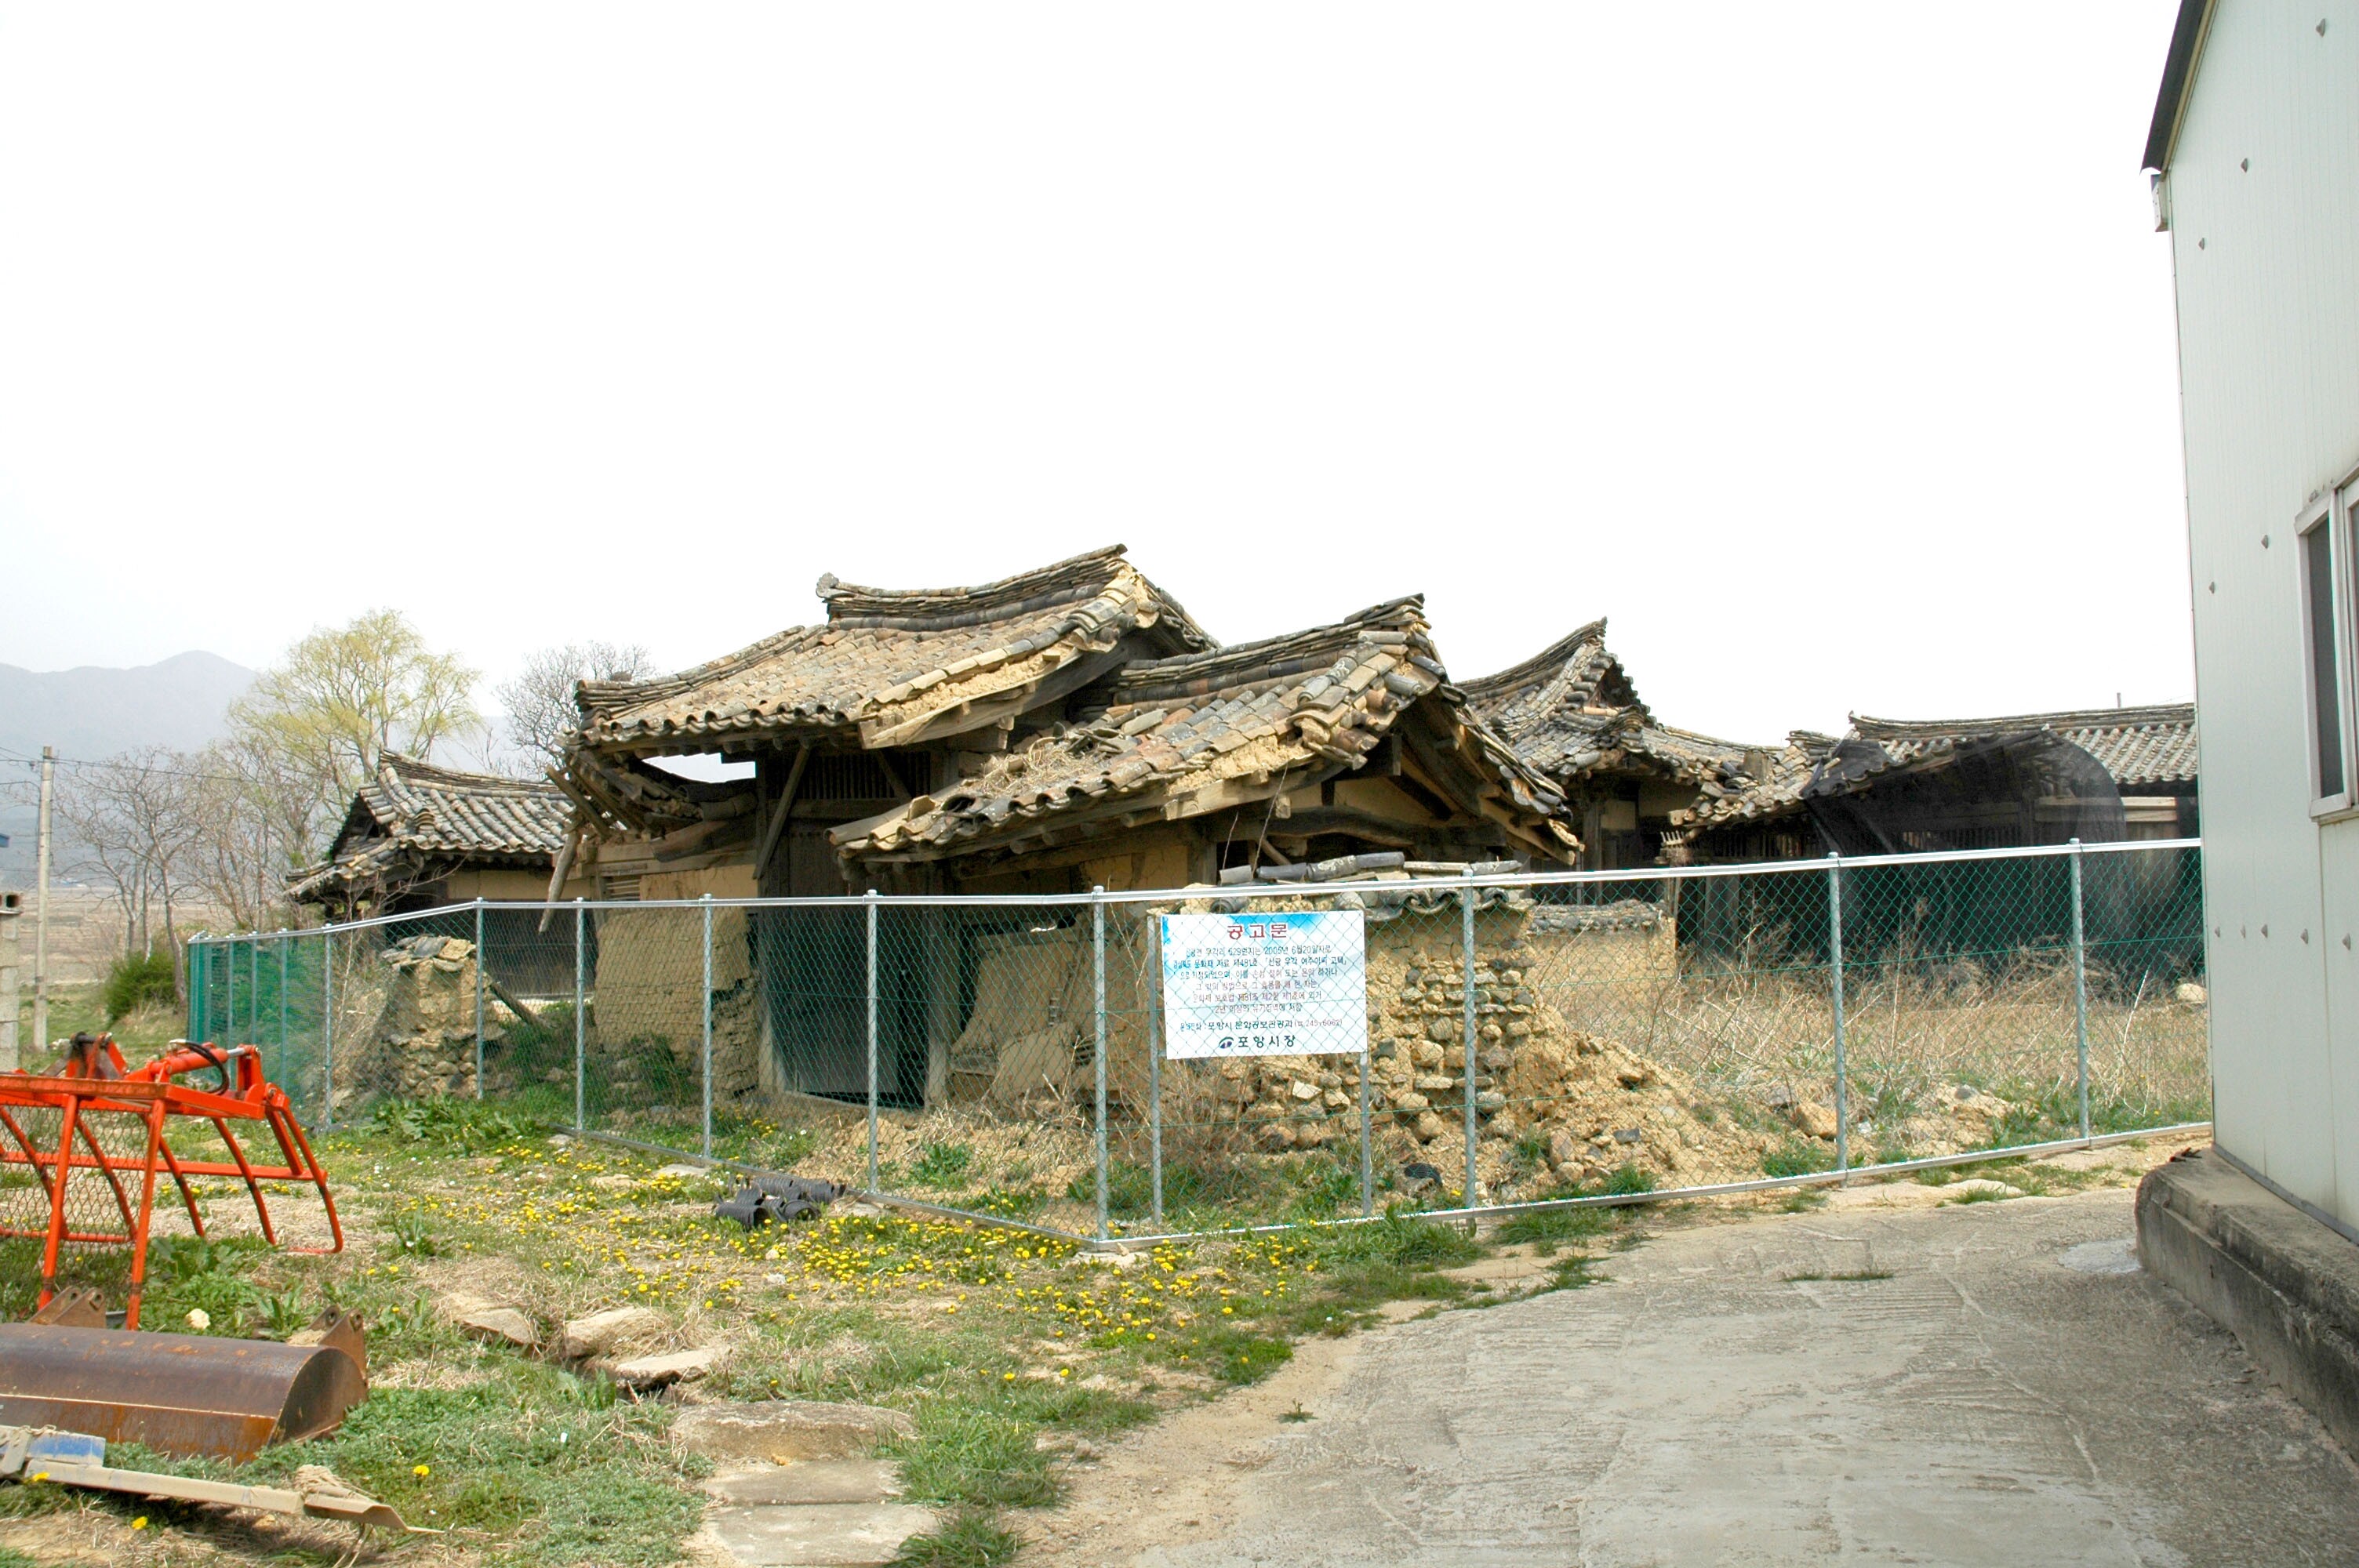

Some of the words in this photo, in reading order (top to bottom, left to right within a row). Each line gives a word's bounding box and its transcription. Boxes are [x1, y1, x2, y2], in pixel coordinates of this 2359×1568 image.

[1227, 924, 1287, 940] 공고문
[1263, 946, 1288, 954] 2005년
[1238, 1035, 1296, 1048] 포항시장
